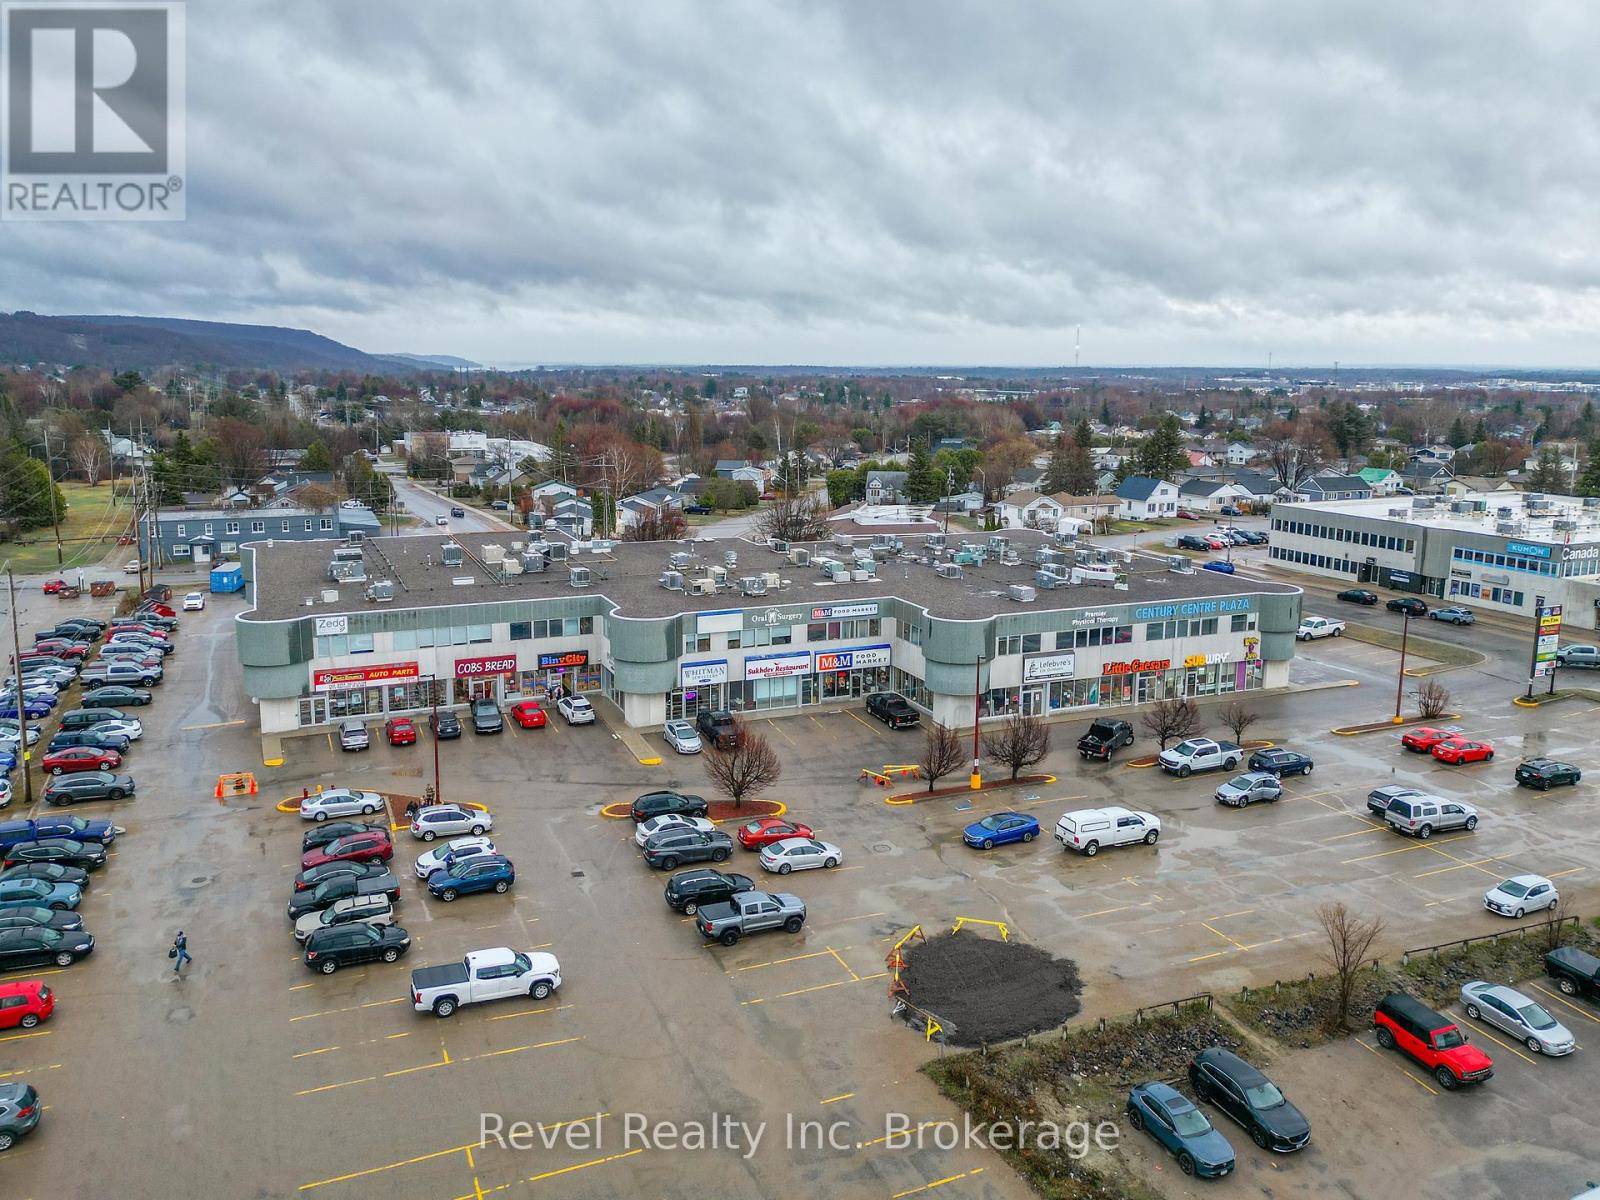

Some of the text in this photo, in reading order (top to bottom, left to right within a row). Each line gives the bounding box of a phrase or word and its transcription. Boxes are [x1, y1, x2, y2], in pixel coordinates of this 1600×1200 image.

[1511, 545, 1545, 555] KUMON
[1562, 546, 1599, 560] Canada
[814, 609, 832, 618] M&M
[1084, 610, 1107, 618] Premier
[1135, 599, 1249, 619] CENTURY CENTRE PLAZA
[751, 612, 803, 623] Oral Surgery
[1072, 615, 1119, 626] Physical Therapy
[319, 618, 345, 629] Zedd
[821, 655, 851, 669] M&M
[855, 657, 887, 665] MARKET
[1184, 653, 1229, 667] SUBWAY
[457, 659, 515, 674] COBS BREAD
[684, 666, 725, 678] WHITMAN
[747, 666, 774, 675] Sukhdev
[775, 663, 809, 672] Restaurant
[1103, 659, 1170, 675] Little Caesars
[368, 668, 414, 679] AUTO PARTS
